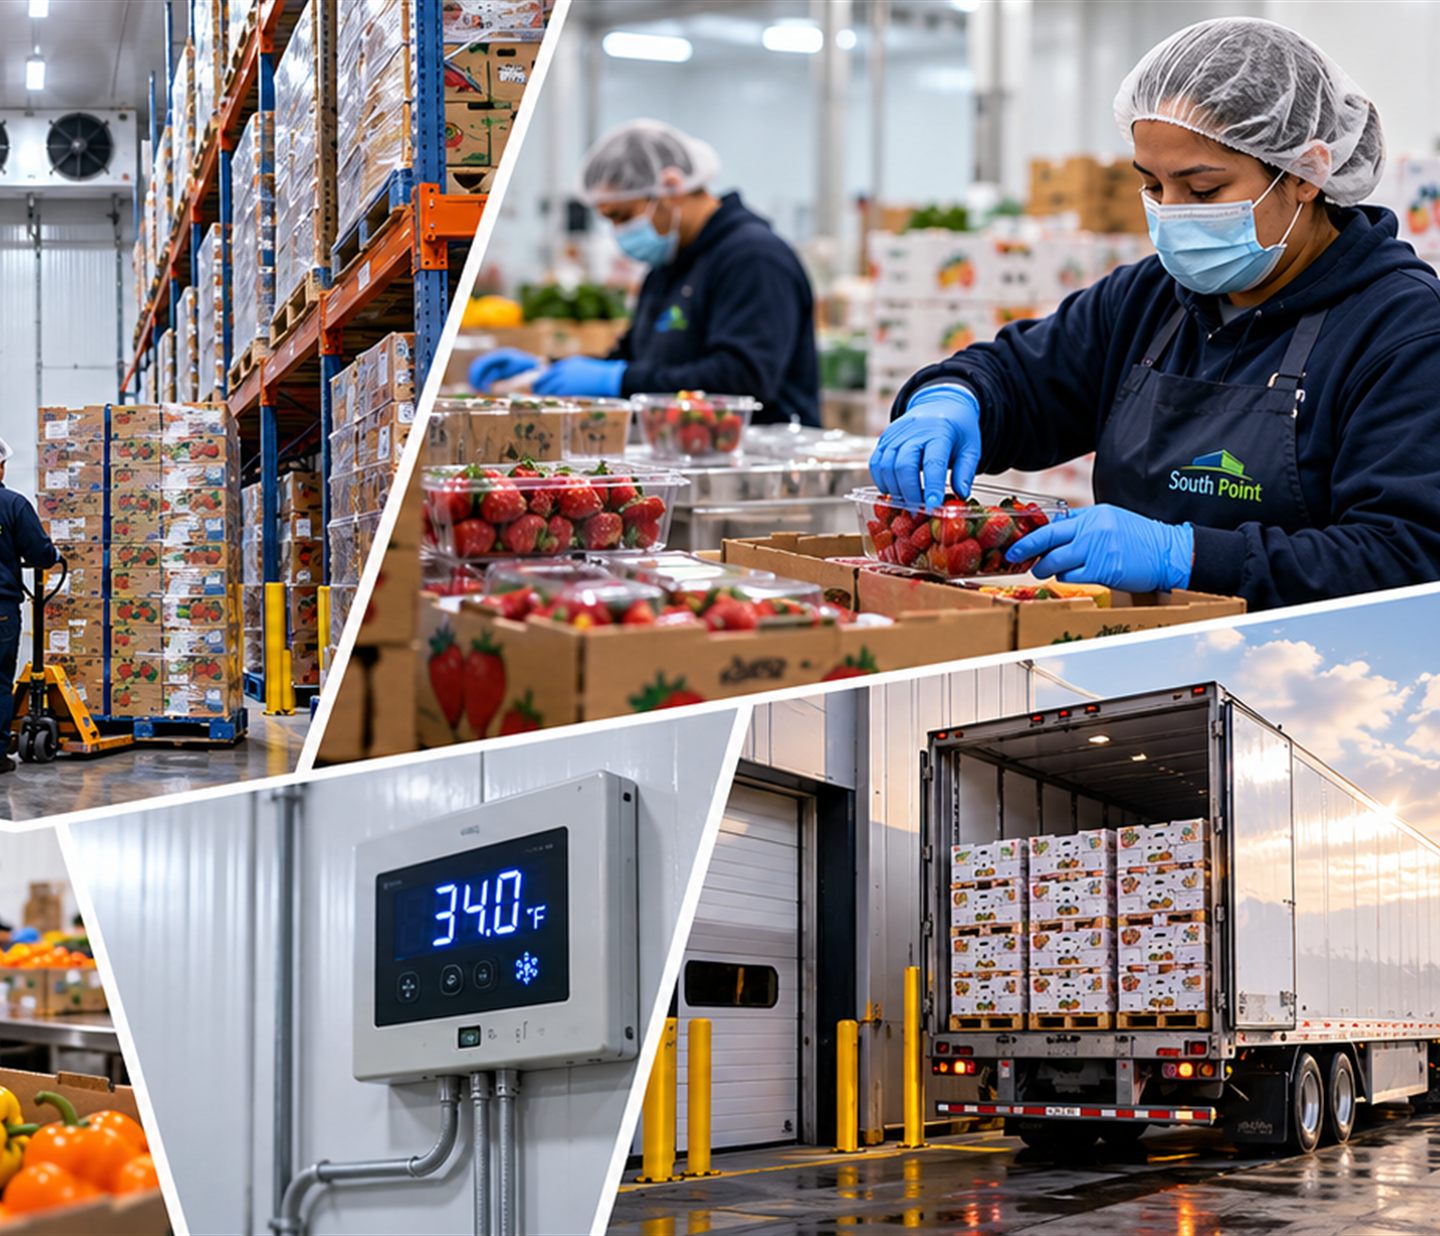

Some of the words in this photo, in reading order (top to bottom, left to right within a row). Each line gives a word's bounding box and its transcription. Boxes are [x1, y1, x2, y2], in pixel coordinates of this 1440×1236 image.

[1168, 470, 1214, 496] South
[1218, 478, 1263, 503] Point
[432, 869, 521, 947] 34.0
